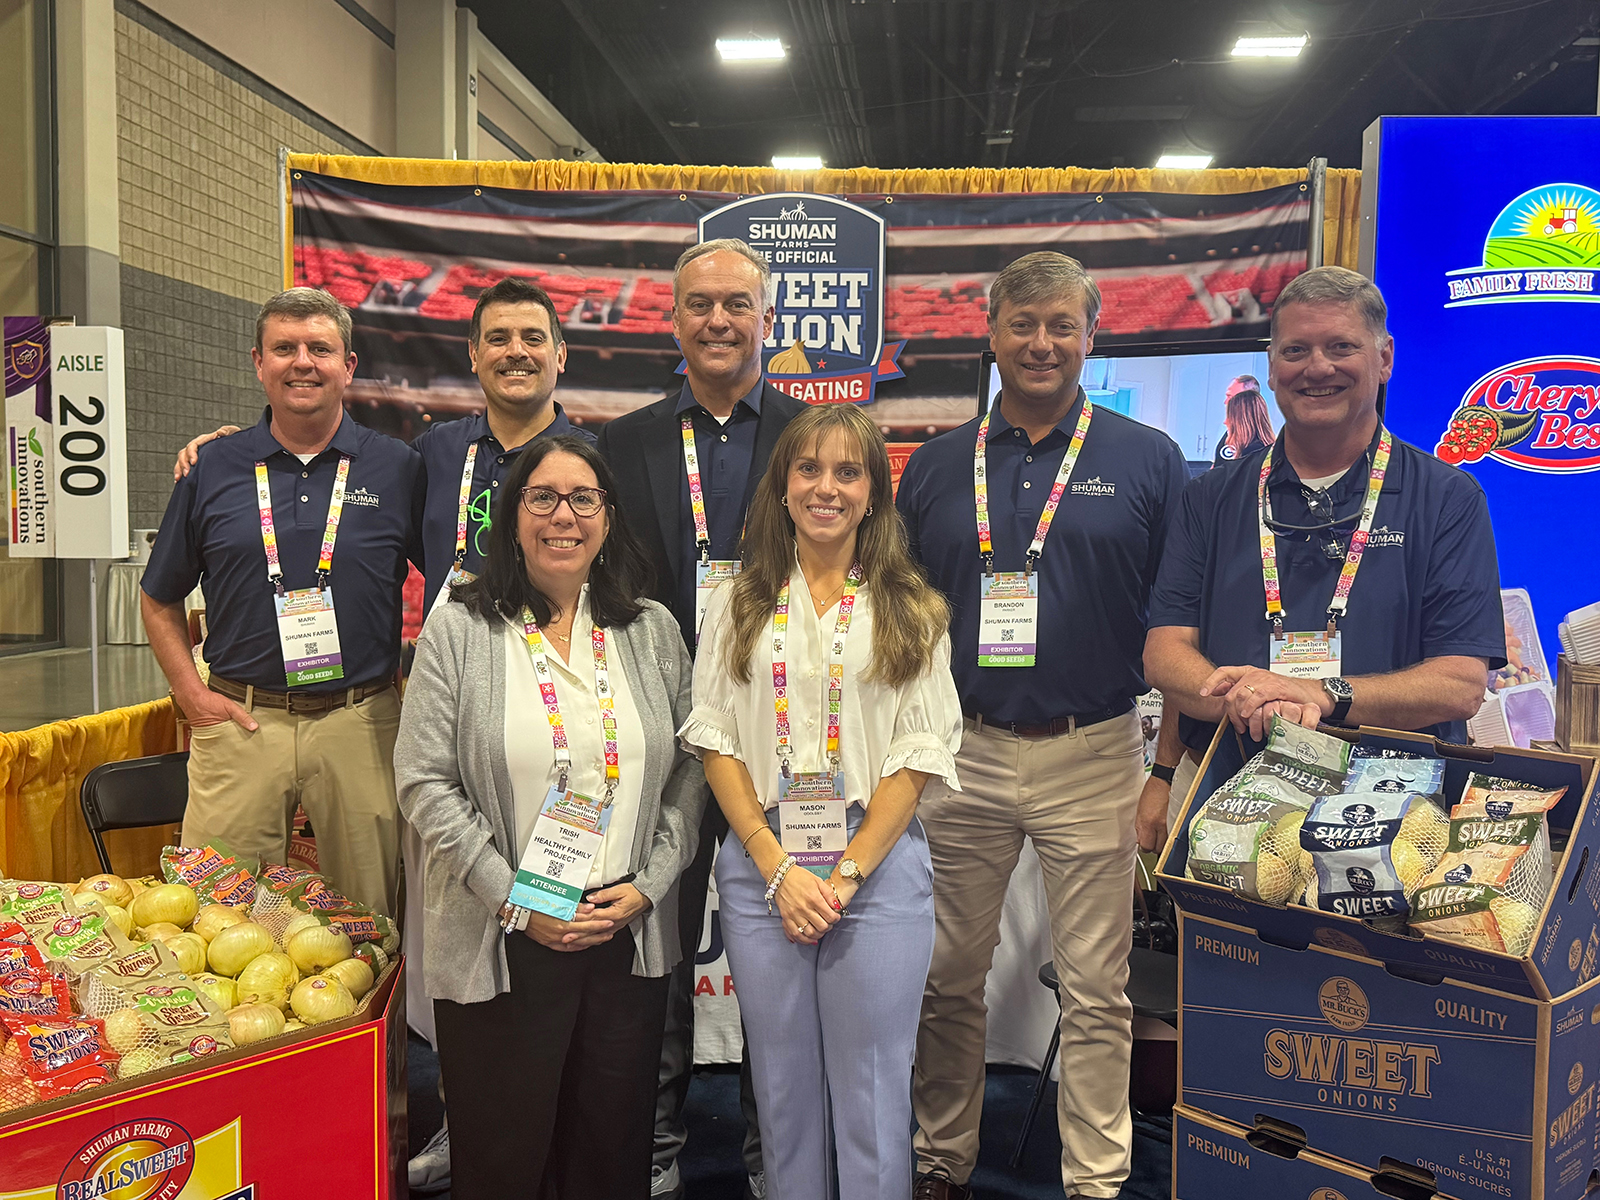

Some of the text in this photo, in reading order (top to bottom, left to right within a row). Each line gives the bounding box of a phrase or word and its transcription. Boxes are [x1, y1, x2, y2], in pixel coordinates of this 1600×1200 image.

[749, 223, 836, 240] SHUMAN
[775, 250, 837, 264] OFFICIAL
[771, 272, 869, 308] EET
[1448, 270, 1595, 300] FAMILY FRESH
[763, 313, 862, 355] ION
[56, 354, 104, 372] AISLE
[773, 379, 863, 401] GATING
[1485, 374, 1600, 419] Chery
[59, 394, 106, 496] 200
[17, 435, 32, 544] innovations
[343, 493, 380, 504] SHUMAN
[1071, 484, 1115, 494] SHUMAN
[34, 458, 49, 544] southern
[1366, 534, 1404, 544] UMAN
[285, 629, 334, 641] SHUMAN FARMS
[297, 657, 330, 668] EXHIBITOR
[315, 670, 334, 679] SEEDS
[1281, 757, 1326, 777] ORGANIC
[1270, 763, 1331, 792] SWEET
[1501, 779, 1544, 791] ONIONS
[559, 805, 597, 821] innovations
[569, 802, 599, 816] southern
[1218, 797, 1277, 815] SWEET
[559, 826, 580, 839] TRISH
[1315, 824, 1388, 841] SWEET
[1458, 818, 1528, 843] SWEET
[534, 836, 592, 860] HEALTHY FAMILY
[1329, 839, 1369, 848] ONIONS
[543, 848, 577, 864] PROJECT
[184, 853, 222, 883] SWEET
[1200, 863, 1239, 873] ORGANIC
[530, 878, 568, 895] ATTENDEE
[1201, 871, 1245, 890] SWEET
[11, 893, 57, 912] Organic
[1180, 890, 1249, 914] PREMIUM
[1333, 896, 1394, 915] SWEET
[1417, 885, 1485, 910] SWEET
[1428, 904, 1466, 917] ONIONS
[342, 921, 376, 933] WEET
[349, 933, 373, 941] NIONS
[1541, 913, 1562, 965] SHUMAN
[1195, 934, 1260, 966] PREMIUM
[1576, 922, 1600, 987] EET
[118, 955, 155, 976] ONIONS
[1424, 948, 1496, 973] QUALITY
[146, 995, 189, 1007] Organic
[1322, 1000, 1337, 1010] MR.
[160, 1004, 194, 1018] SWEET
[1435, 998, 1508, 1031] QUALITY
[1555, 1009, 1584, 1033] SHUMAN
[28, 1024, 100, 1062] SWEET
[47, 1040, 100, 1070] ONIONS
[1264, 1028, 1441, 1098] SWEET
[1317, 1088, 1398, 1112] ONIONS
[1550, 1081, 1595, 1149] SWEET
[79, 1123, 173, 1165] SHUMAN FARMS
[1187, 1133, 1250, 1169] PREMIUM
[1475, 1149, 1511, 1168] U.S. #1
[1416, 1158, 1512, 1198] OIGNONS SUCRÉS
[1486, 1164, 1510, 1180] NO.1
